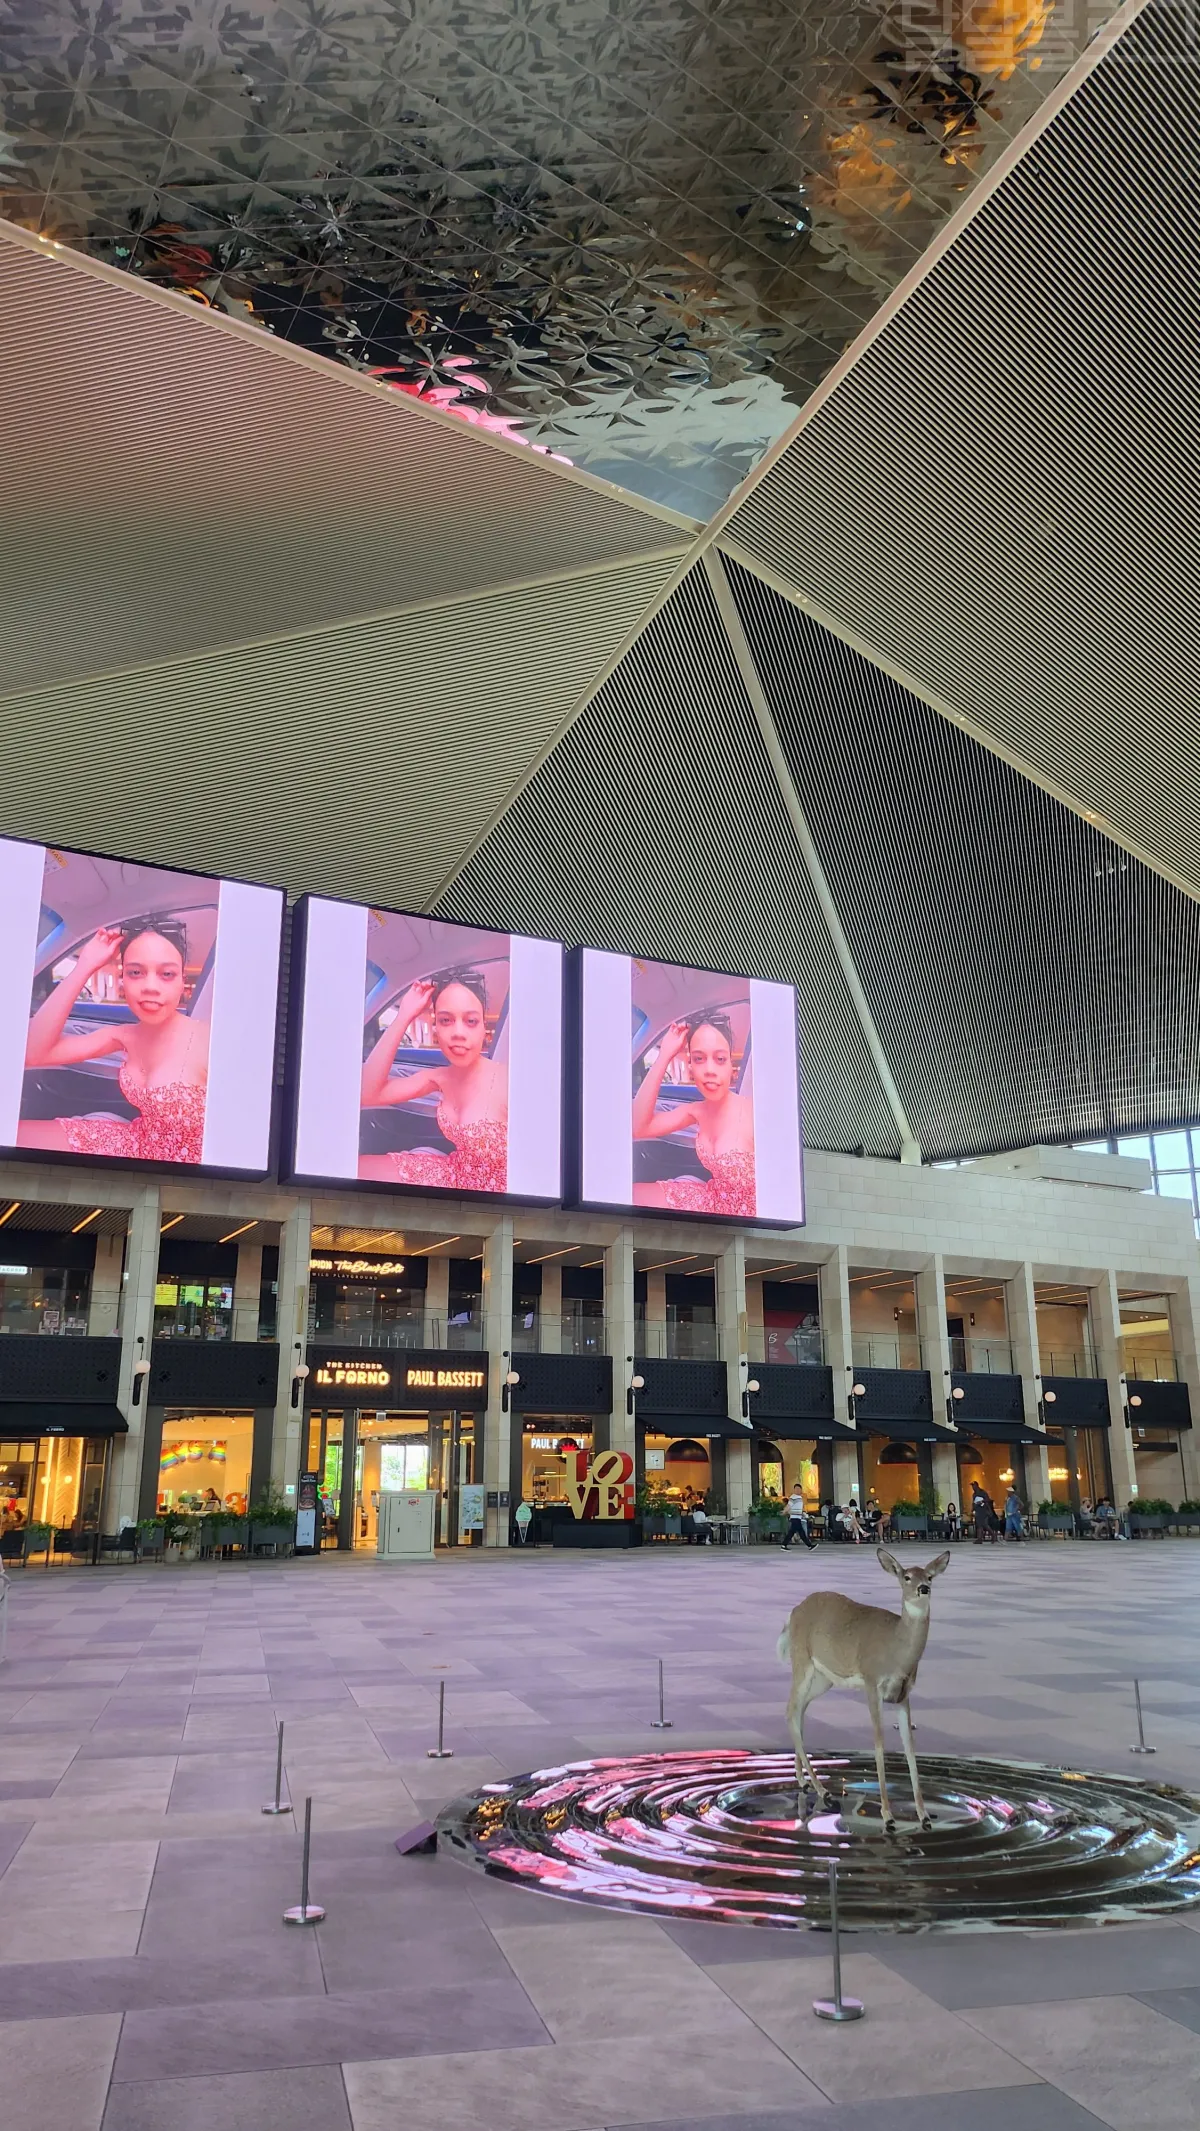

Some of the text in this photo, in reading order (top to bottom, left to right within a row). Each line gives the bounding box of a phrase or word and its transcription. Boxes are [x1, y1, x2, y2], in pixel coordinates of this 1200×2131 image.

[326, 1361, 383, 1370] THE KITCHEN
[317, 1369, 390, 1386] IL FORNO
[407, 1368, 484, 1388] PAUL BASSETT
[530, 1438, 551, 1449] PAUL
